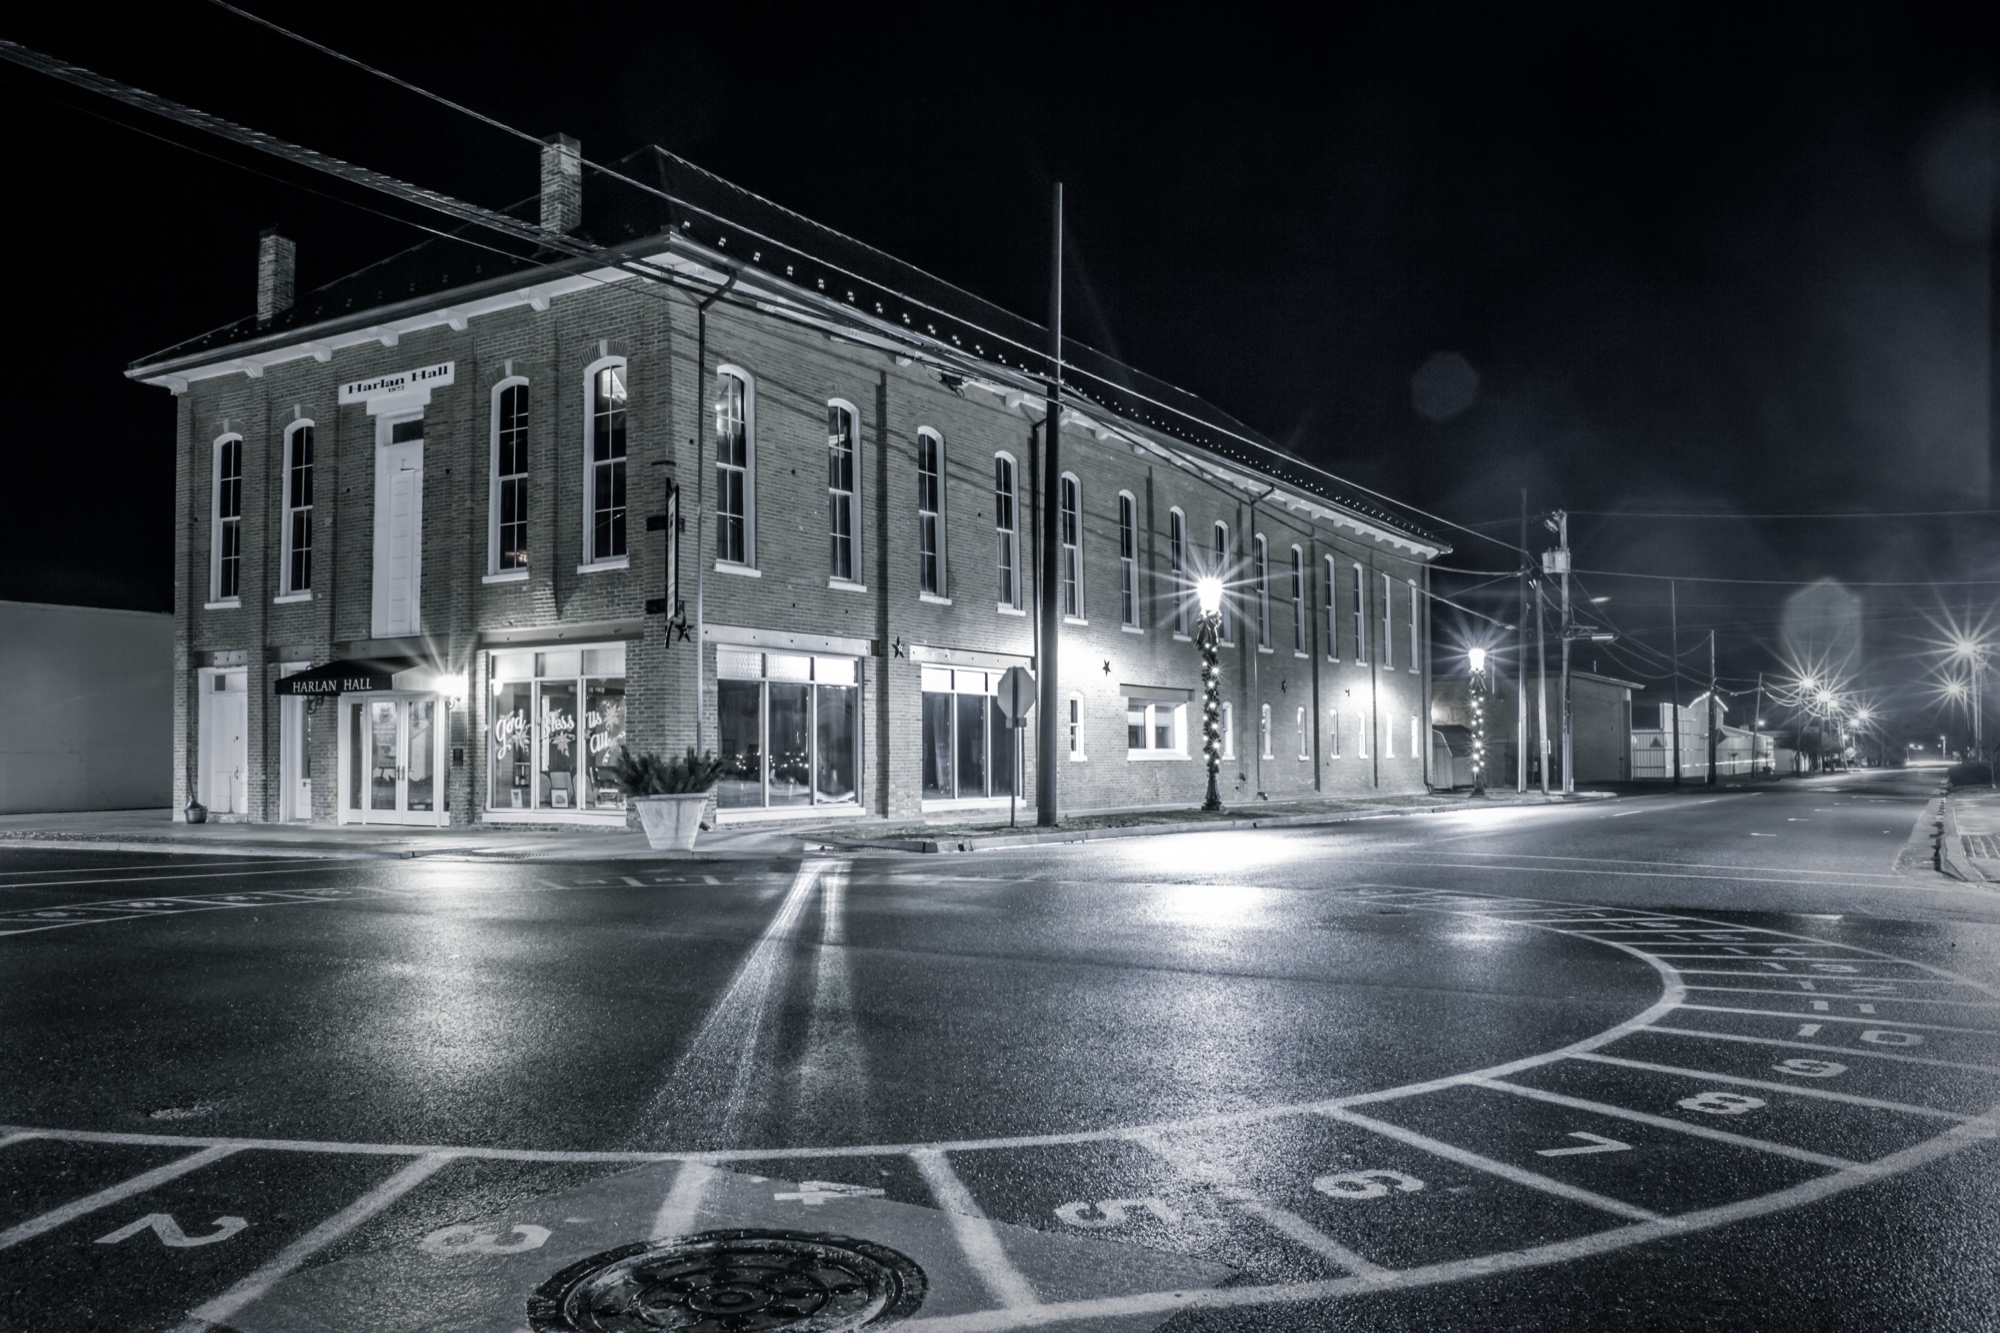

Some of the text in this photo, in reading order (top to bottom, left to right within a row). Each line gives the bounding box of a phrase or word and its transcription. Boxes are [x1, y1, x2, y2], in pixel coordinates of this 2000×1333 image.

[348, 365, 448, 394] Harlan Hall
[292, 678, 373, 693] HARLAN HALL
[1797, 1022, 1924, 1047] 10
[1676, 1091, 1768, 1115] 8
[1535, 1131, 1633, 1157] 7
[774, 1180, 886, 1205] 4
[1312, 1169, 1425, 1200] 6
[93, 1213, 249, 1248] 2
[420, 1224, 552, 1254] 3
